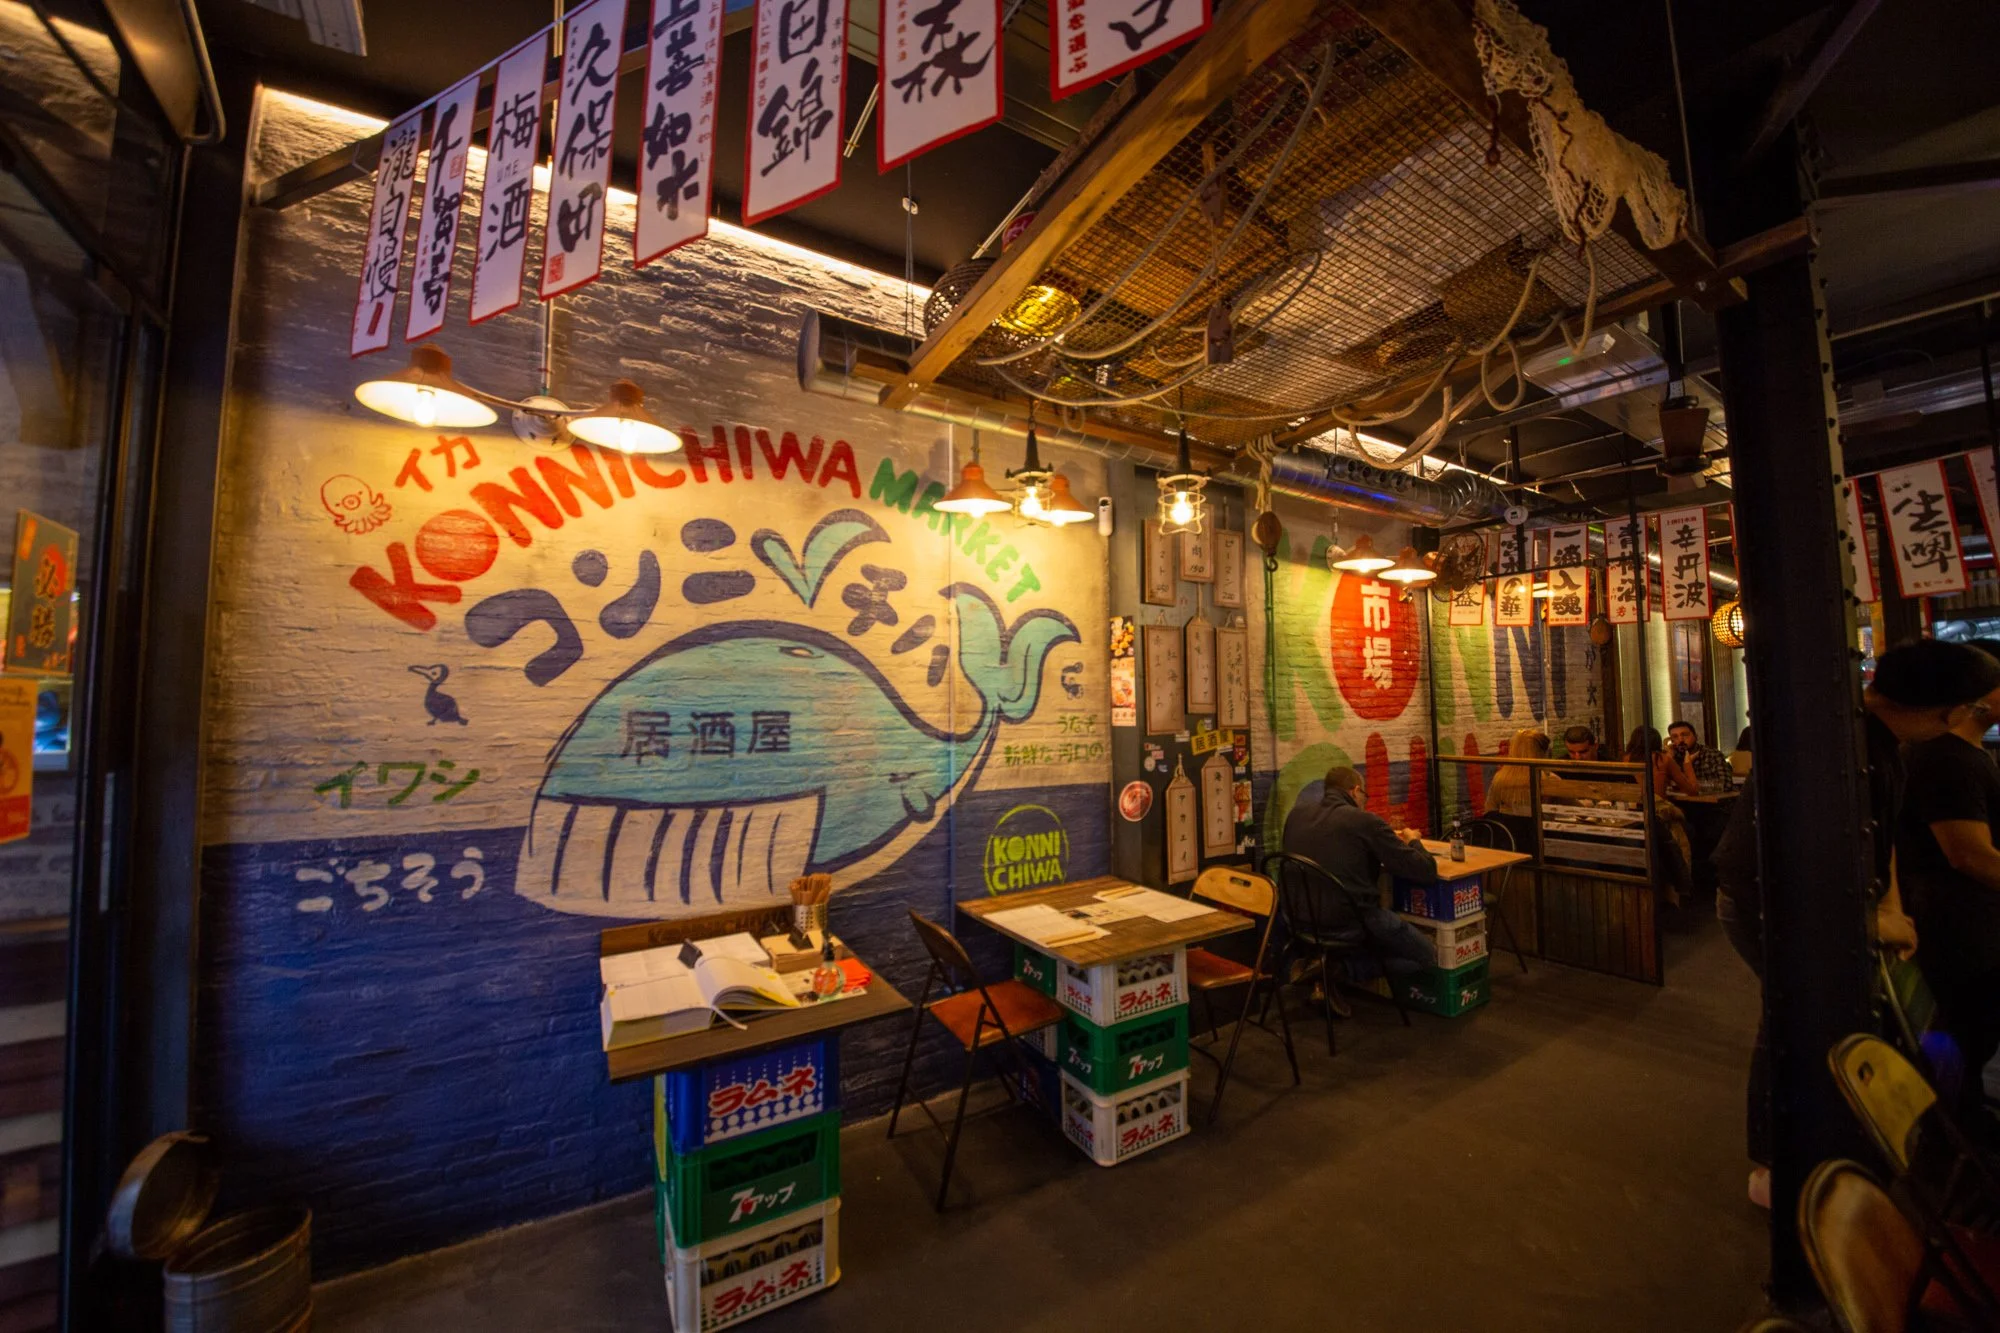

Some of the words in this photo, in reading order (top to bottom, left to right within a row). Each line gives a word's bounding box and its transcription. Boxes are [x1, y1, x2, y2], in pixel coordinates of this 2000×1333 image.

[559, 22, 619, 253] 久保田
[394, 434, 481, 492] イカ
[349, 425, 862, 632] KONNICHIWA
[868, 457, 1043, 604] MARKET
[1670, 524, 1706, 609] 辛丹波
[464, 517, 951, 688] コンニチハ
[1360, 580, 1394, 690] 市場
[622, 709, 792, 766] 居酒屋
[313, 760, 481, 809] イワシ
[991, 859, 1064, 892] CHIWA
[992, 830, 1061, 863] KONNI
[295, 847, 485, 913] ごちそう
[1119, 981, 1173, 1012] ラムネ
[709, 1065, 817, 1117] ラムネ
[1121, 1111, 1175, 1149] ラムネ
[713, 1258, 810, 1319] ラムネ
